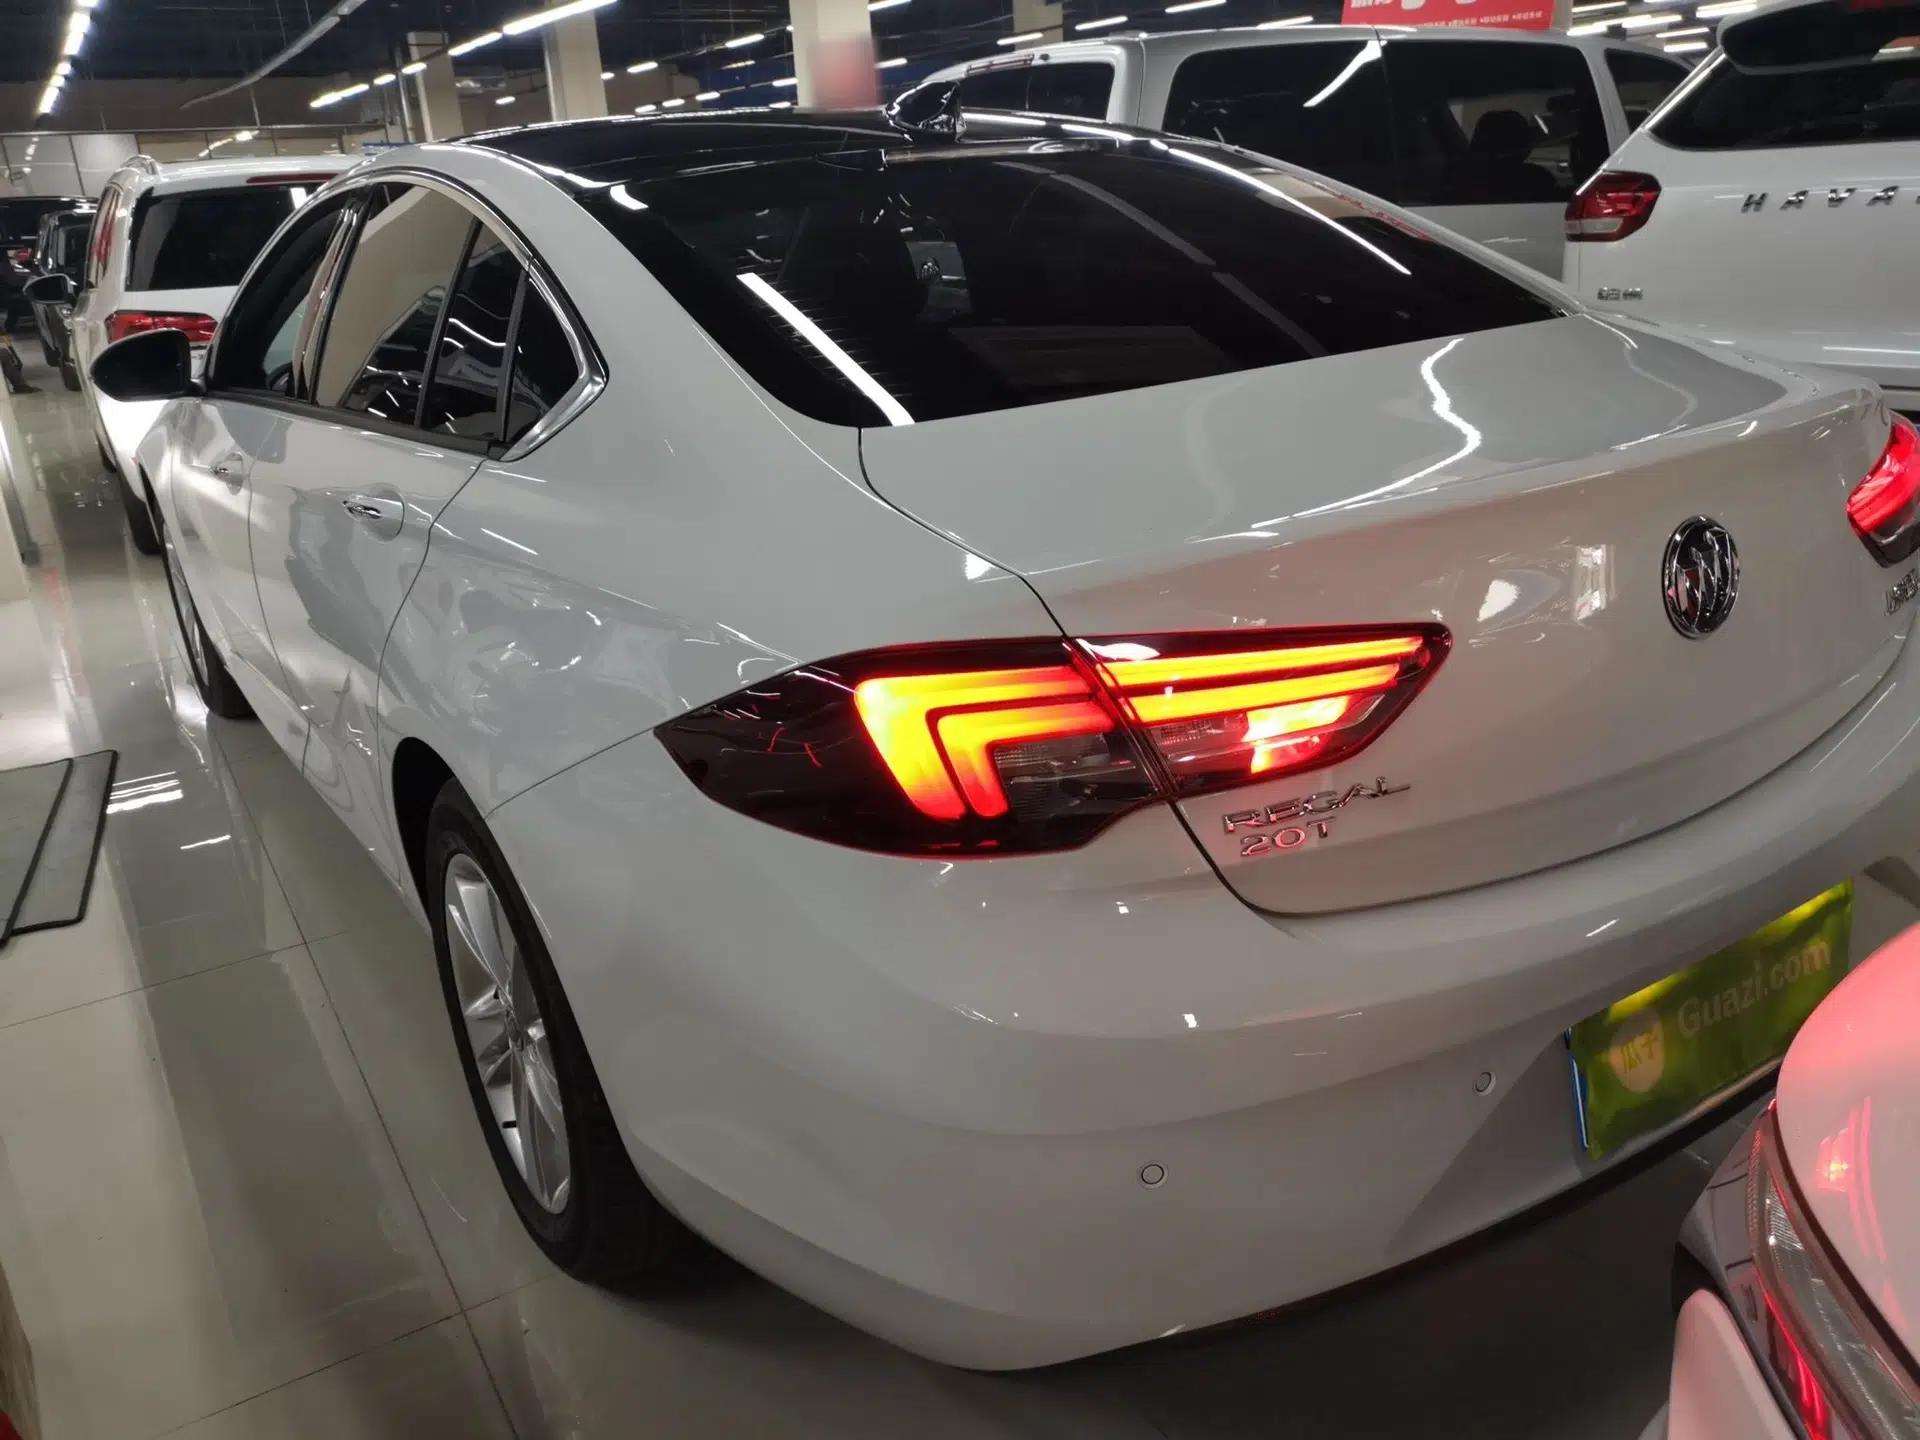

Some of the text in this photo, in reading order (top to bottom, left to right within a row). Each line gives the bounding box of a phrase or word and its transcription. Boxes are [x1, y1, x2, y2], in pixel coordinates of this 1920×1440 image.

[1741, 185, 1920, 213] HAVA
[1223, 776, 1411, 833] REGAL
[1240, 816, 1336, 857] 20T
[1677, 940, 1832, 1040] Guazi.com
